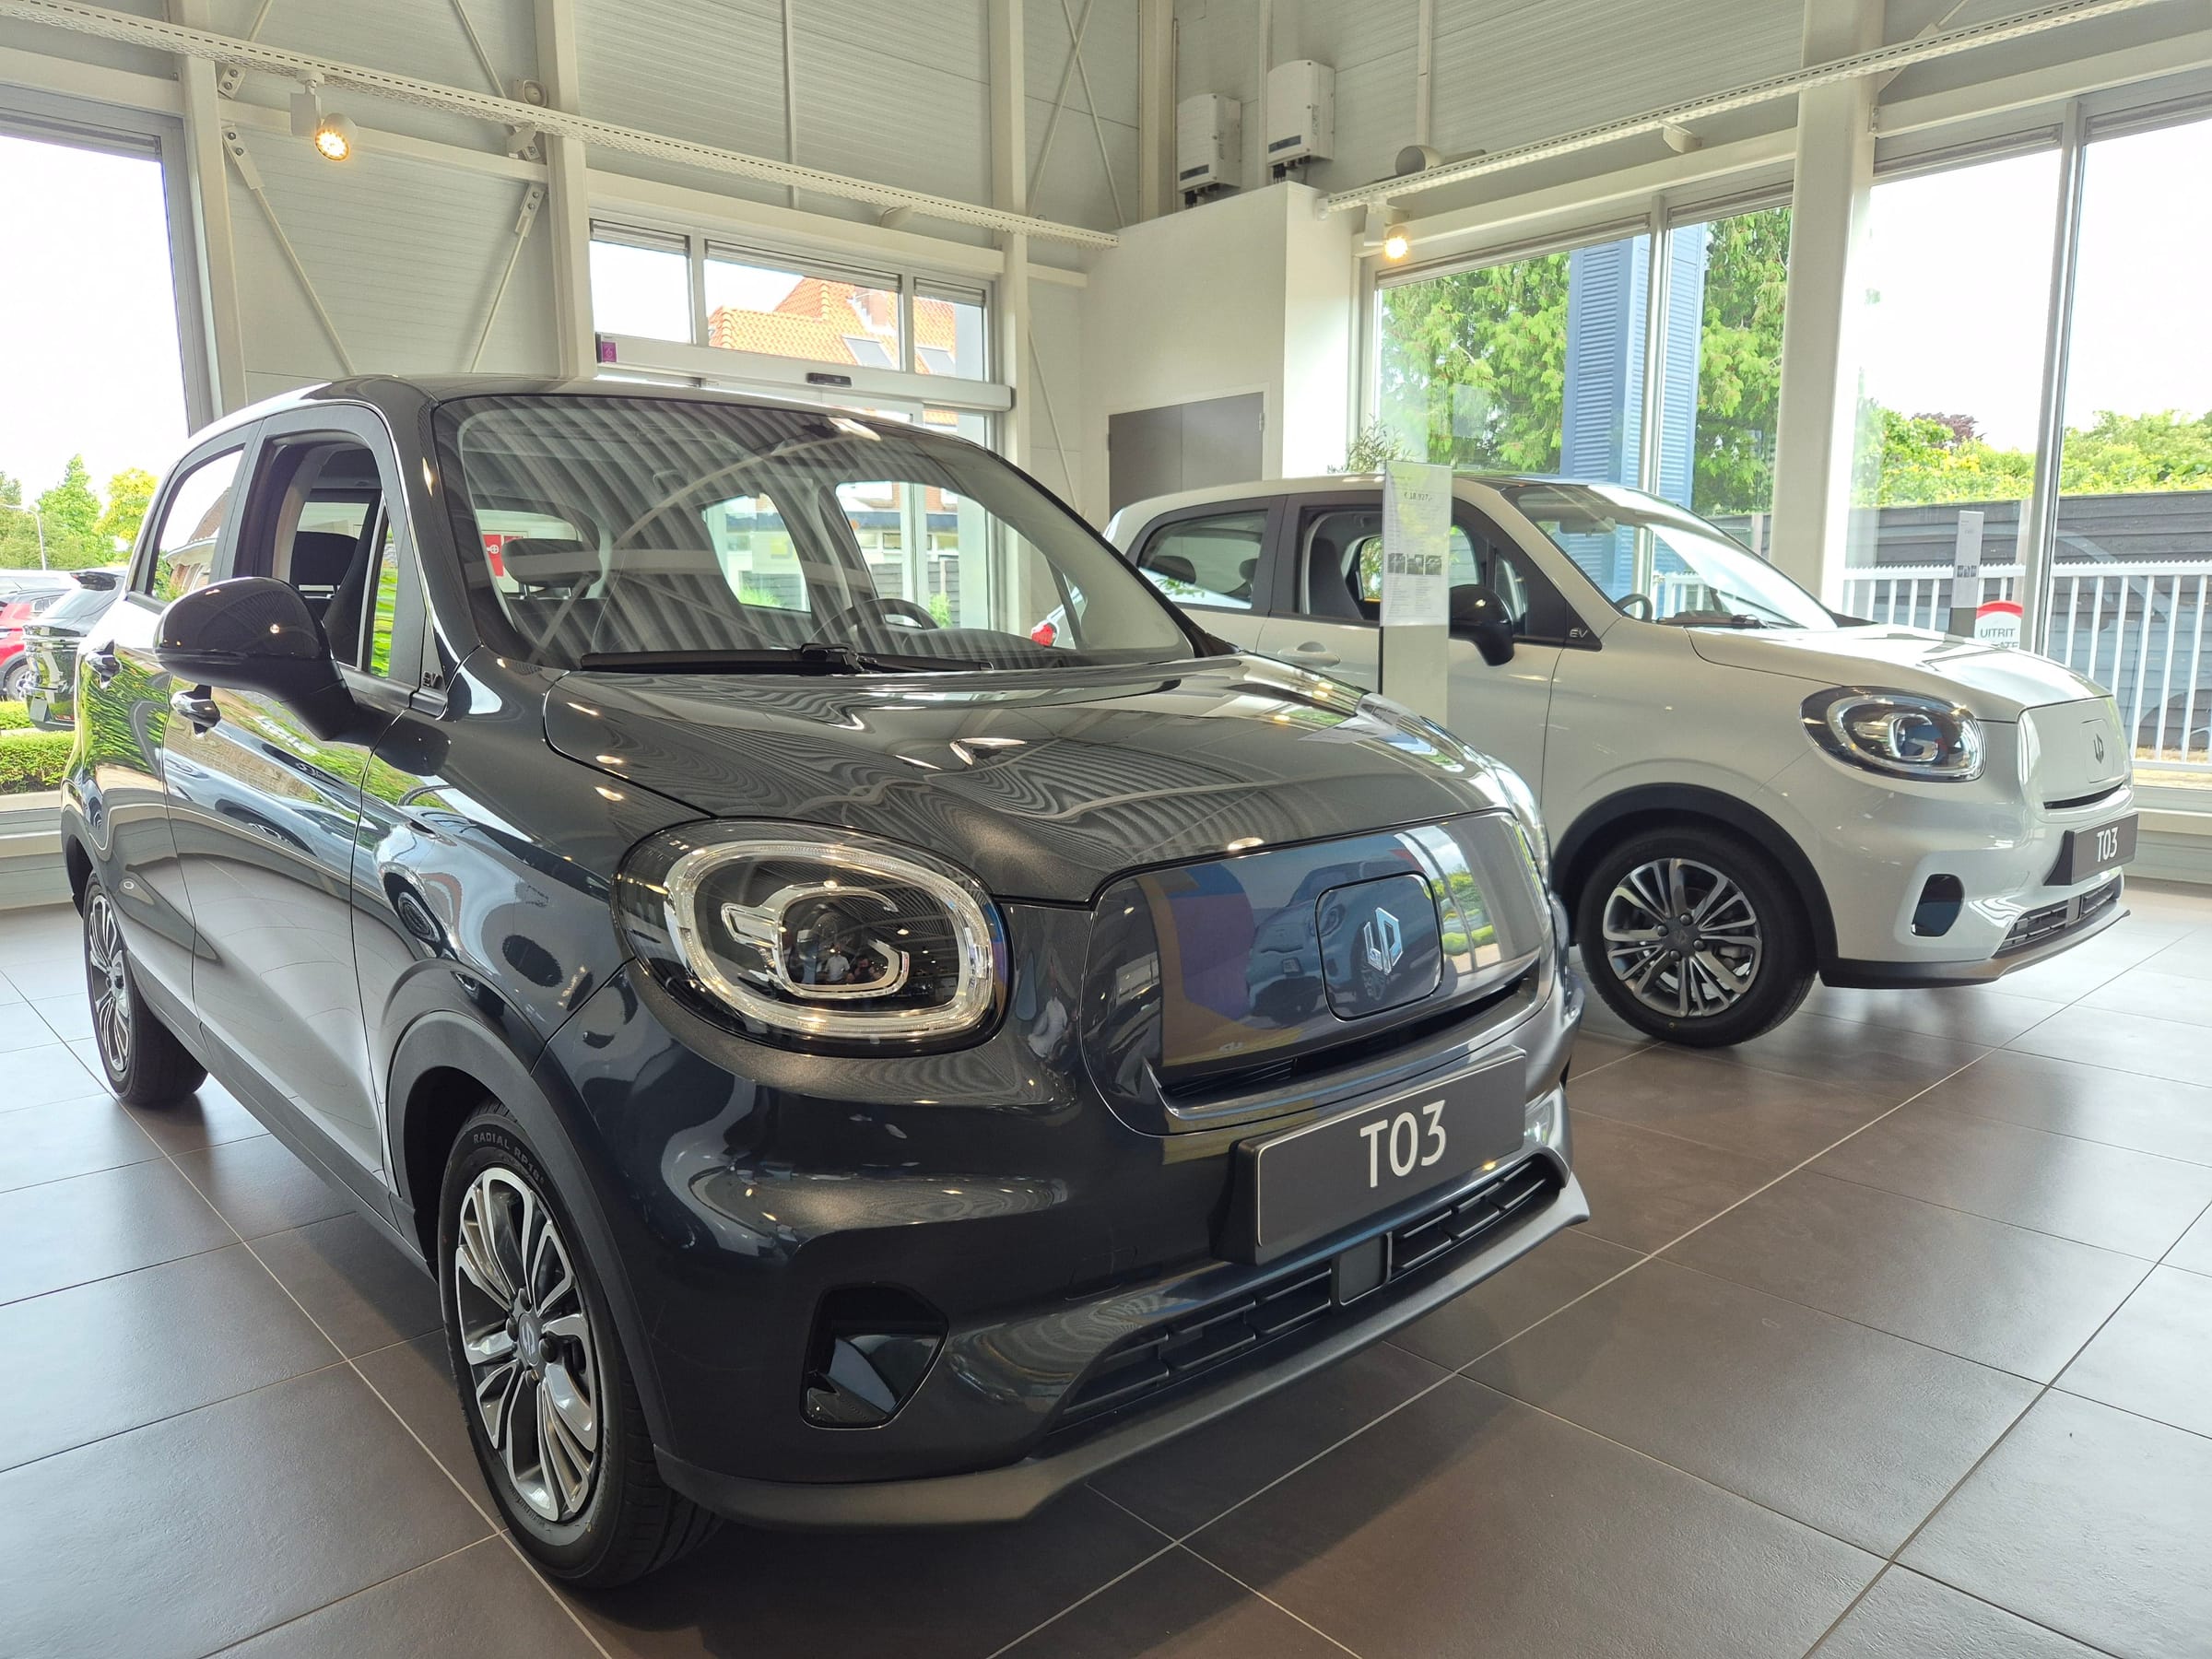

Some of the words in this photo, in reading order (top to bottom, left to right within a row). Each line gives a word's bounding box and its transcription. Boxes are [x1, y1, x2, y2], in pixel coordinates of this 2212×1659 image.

[1569, 628, 1588, 638] EV
[1980, 628, 2016, 638] UITRIT
[2097, 827, 2119, 863] T03
[473, 1132, 510, 1150] RADIAL
[1359, 1100, 1447, 1188] T03
